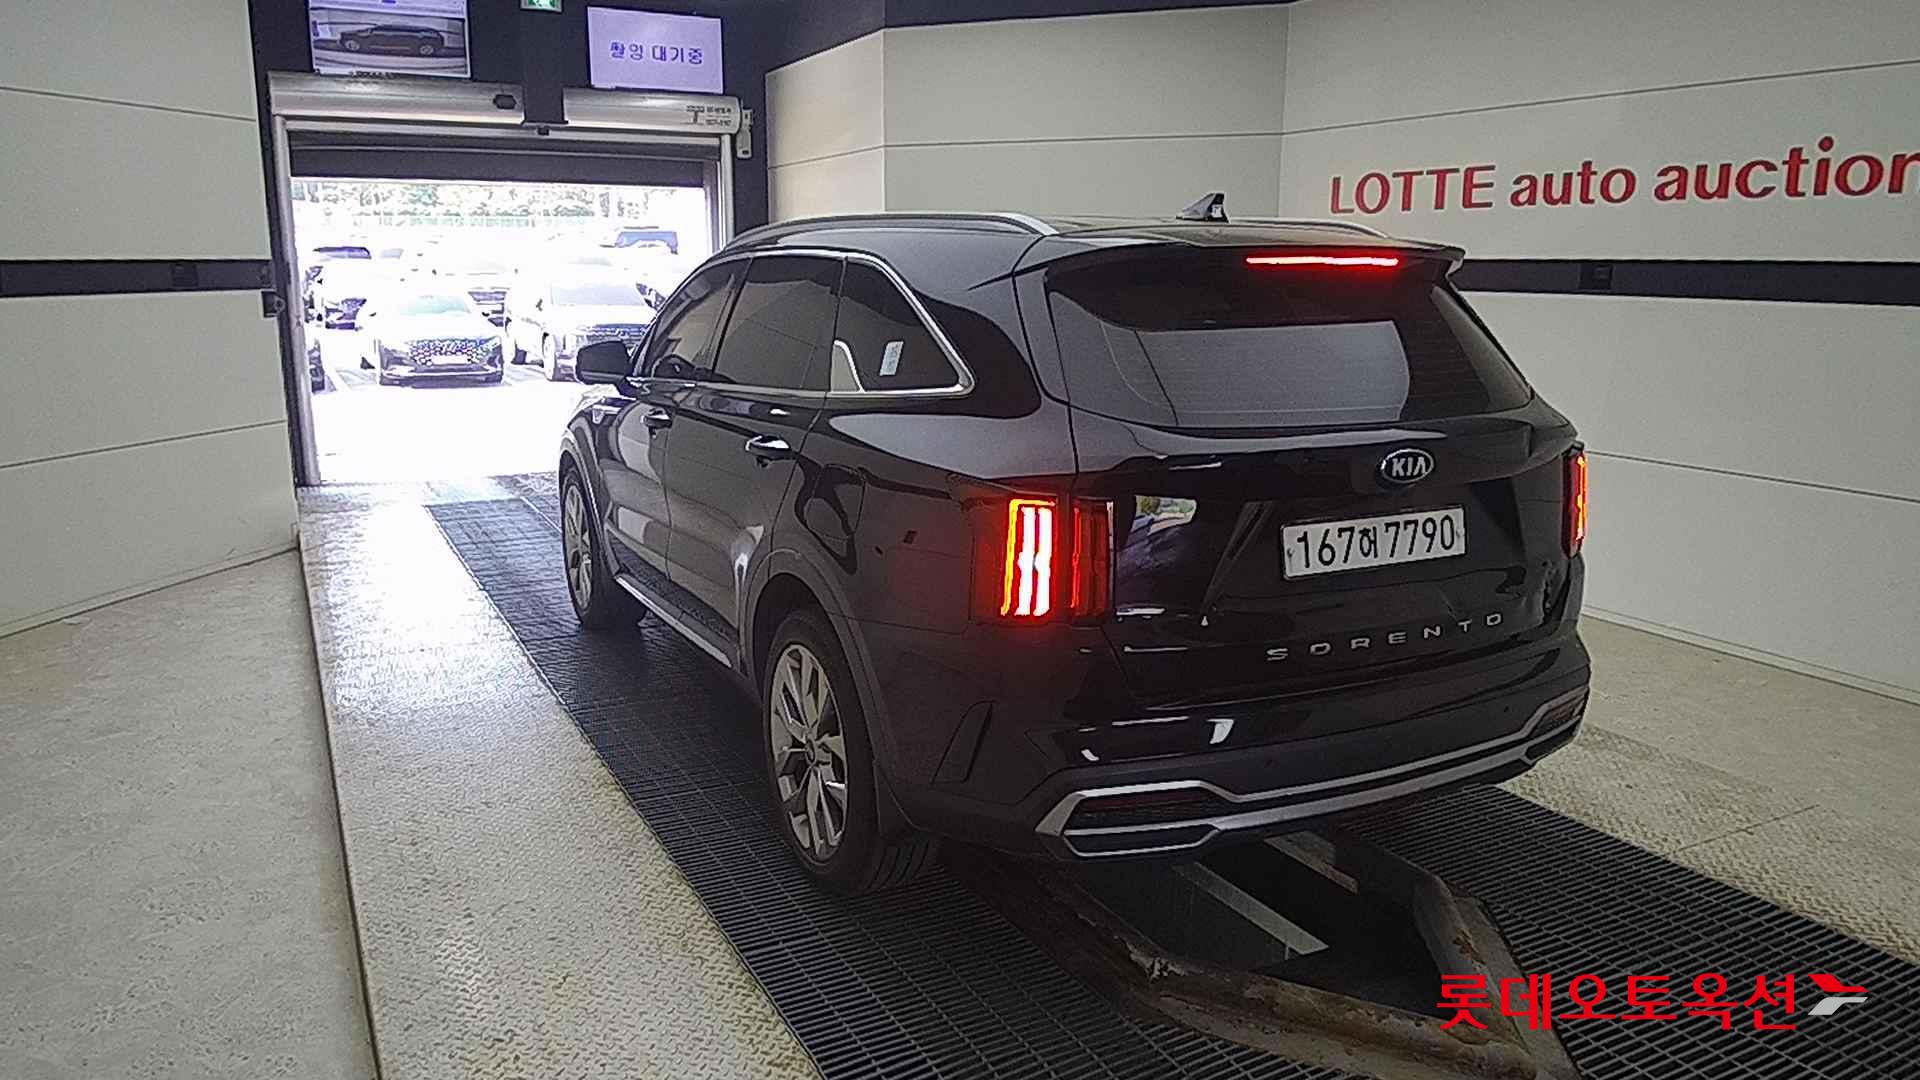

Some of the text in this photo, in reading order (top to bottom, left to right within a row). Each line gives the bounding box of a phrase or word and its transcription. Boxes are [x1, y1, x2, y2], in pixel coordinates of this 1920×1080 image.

[652, 45, 703, 65] 대기중
[1331, 166, 1495, 214] LOTTE
[1510, 160, 1636, 208] auto
[1391, 456, 1428, 477] KIA
[1266, 613, 1504, 662] SORENTO
